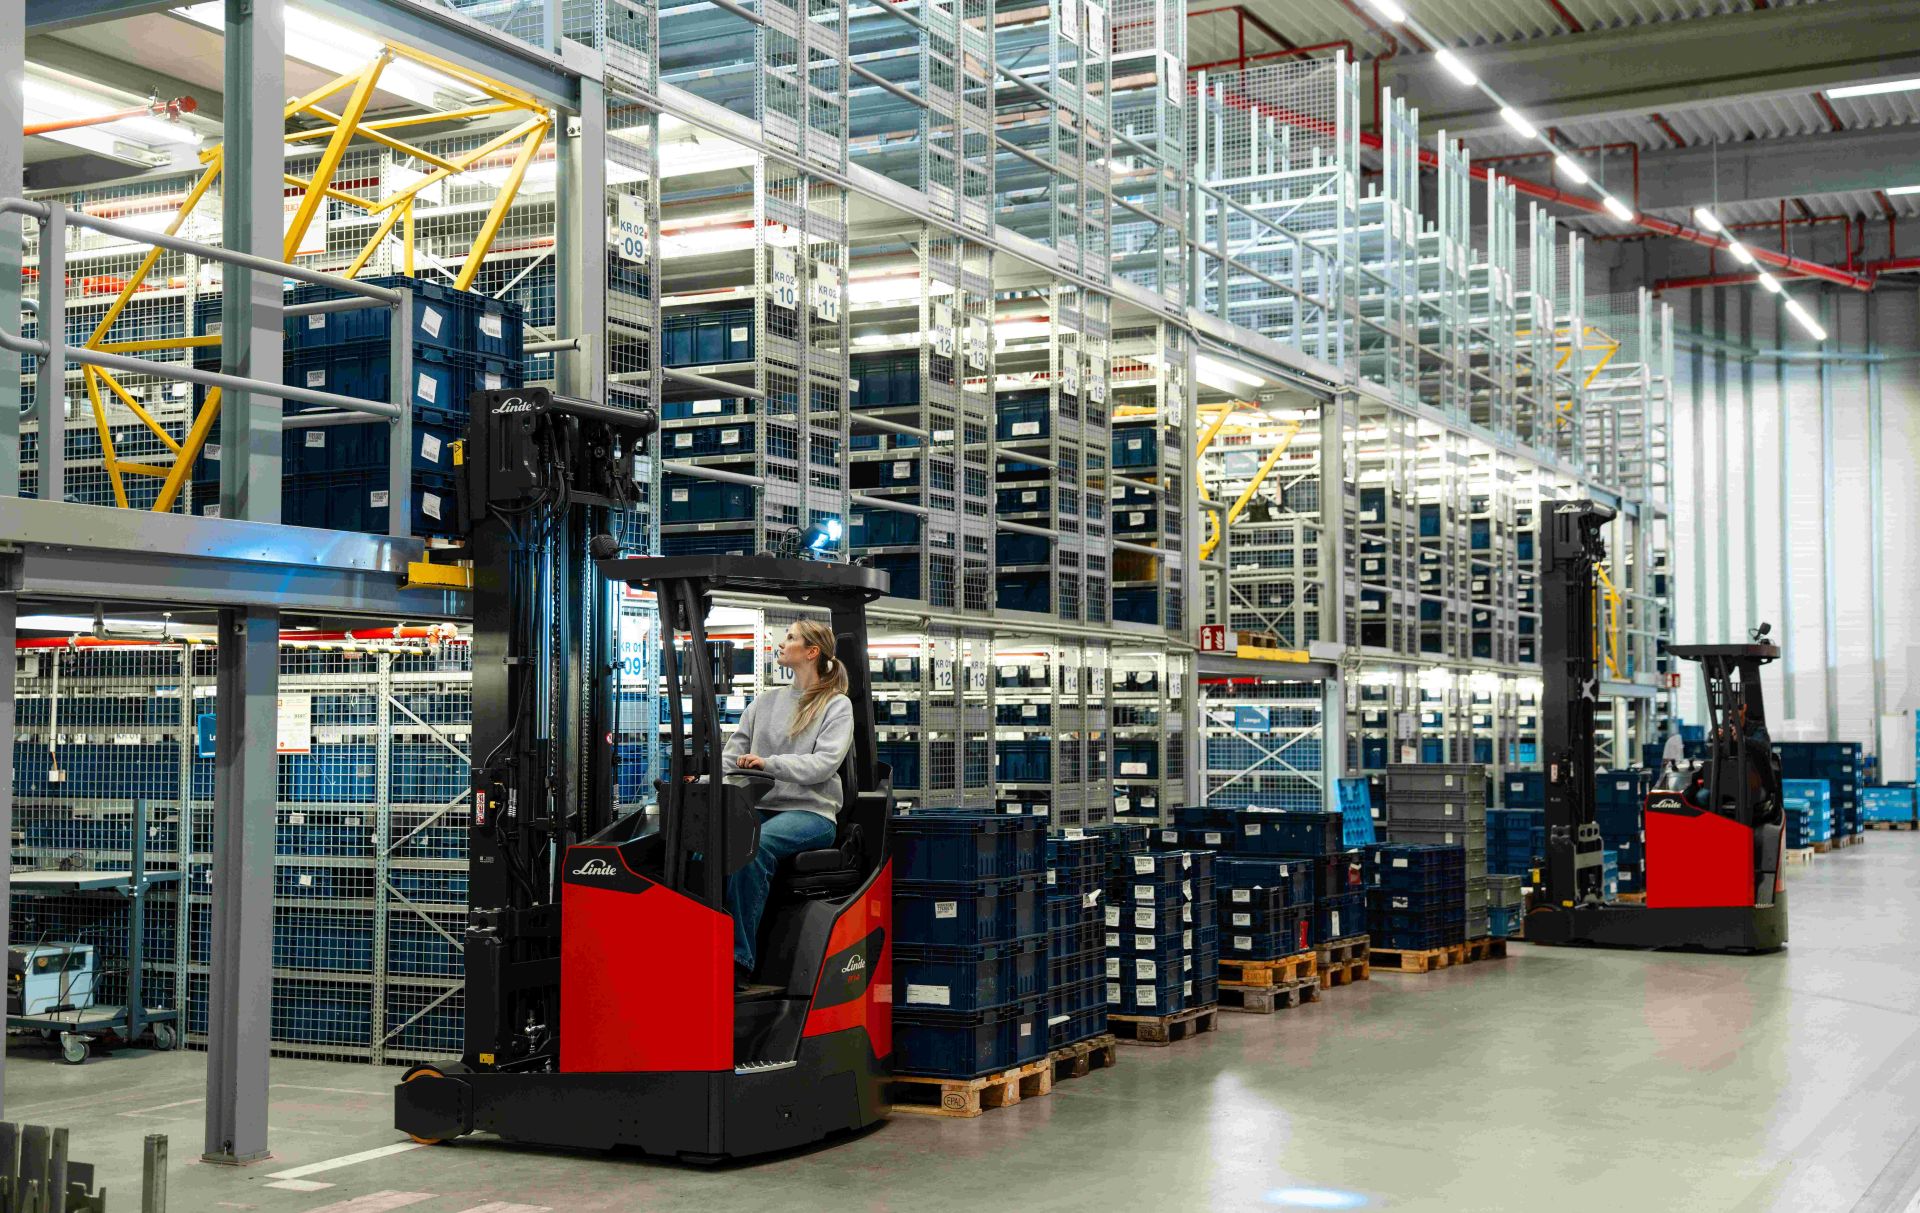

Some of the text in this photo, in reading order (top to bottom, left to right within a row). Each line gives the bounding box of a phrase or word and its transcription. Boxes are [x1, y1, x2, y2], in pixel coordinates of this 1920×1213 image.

[620, 220, 644, 236] KR 02
[620, 237, 643, 258] -09
[774, 271, 794, 286] KR 02
[775, 286, 794, 304] -10
[818, 284, 828, 295] KR
[818, 300, 835, 317] -11
[936, 338, 951, 354] -12
[492, 397, 532, 413] Linde
[633, 642, 641, 652] 01
[936, 660, 951, 668] KR 01
[936, 672, 951, 686] -12
[971, 672, 985, 687] -13
[1652, 798, 1681, 808] Linde
[572, 858, 616, 876] Linde
[842, 954, 866, 973] Linde
[946, 1097, 962, 1106] EPAL
